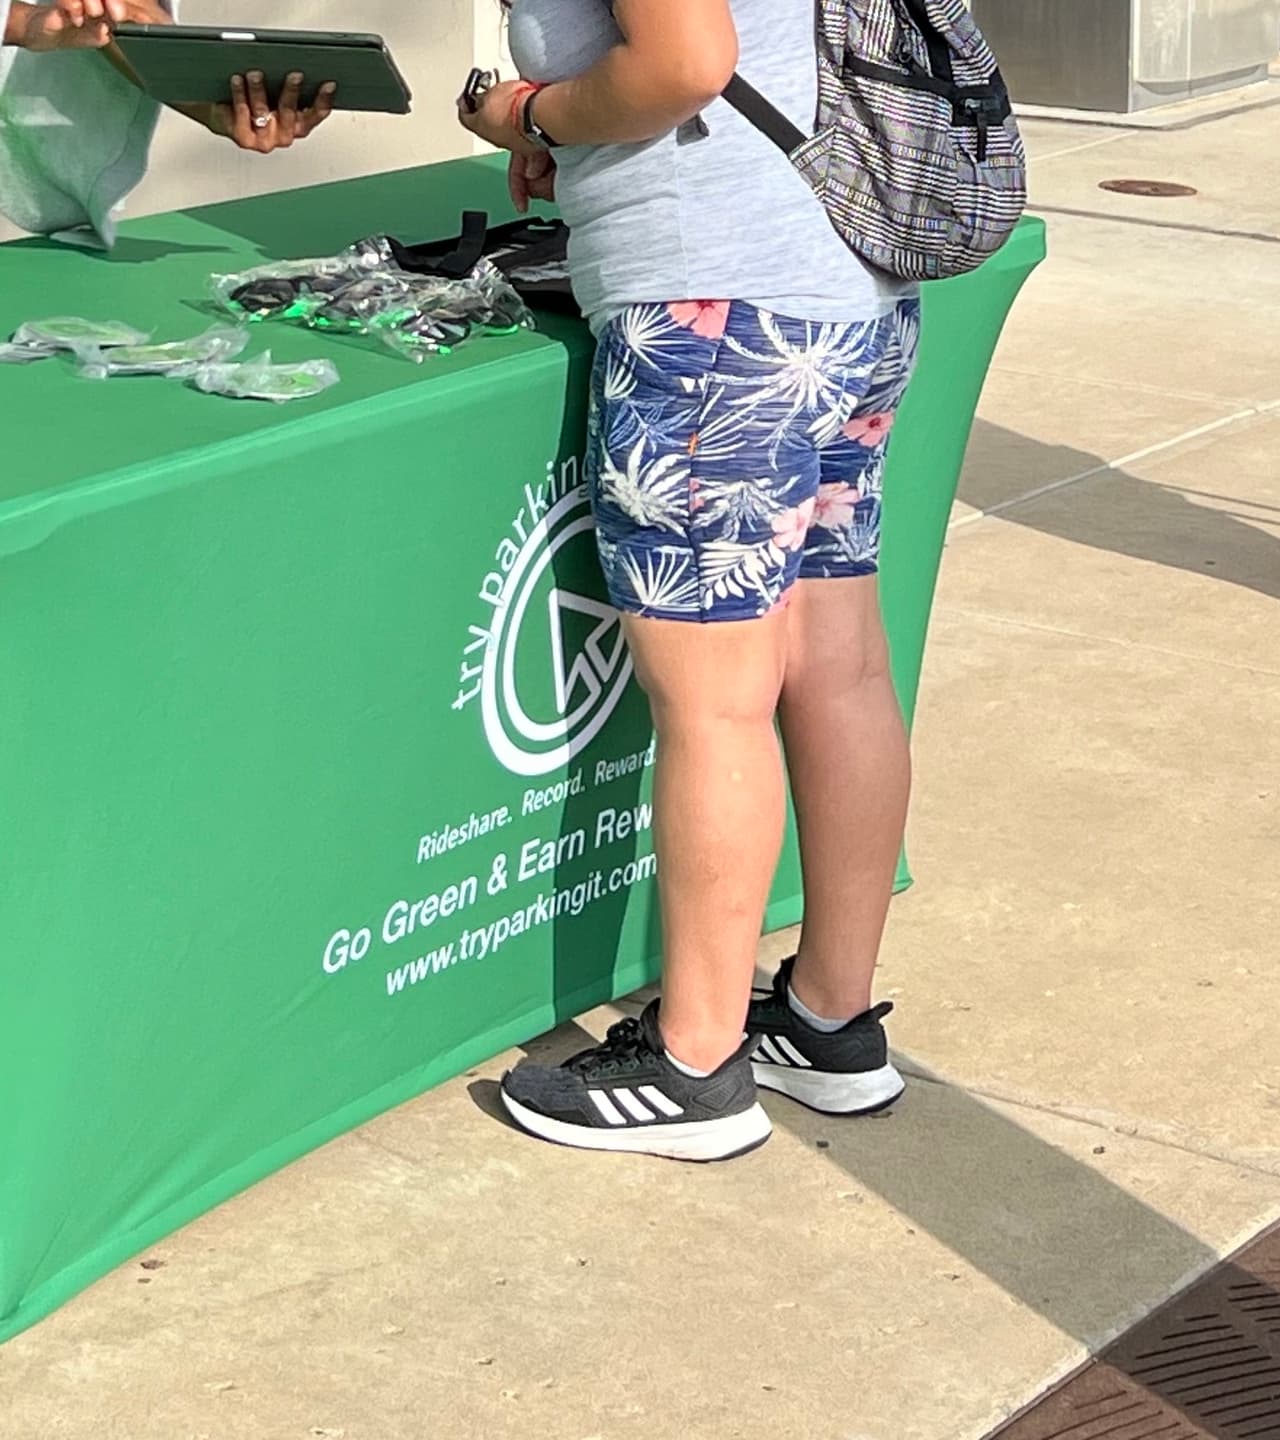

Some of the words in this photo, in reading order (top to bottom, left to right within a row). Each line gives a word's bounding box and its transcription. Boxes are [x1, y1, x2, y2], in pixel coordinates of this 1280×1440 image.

[451, 623, 495, 711] try
[417, 805, 513, 864] Rideshare.
[522, 767, 586, 817] Record.
[322, 927, 372, 974] Go
[381, 875, 478, 945] Green
[486, 852, 508, 896] &
[517, 828, 586, 882] Earn
[594, 801, 654, 849] Rew
[385, 852, 657, 997] www.tryparkingit.com
